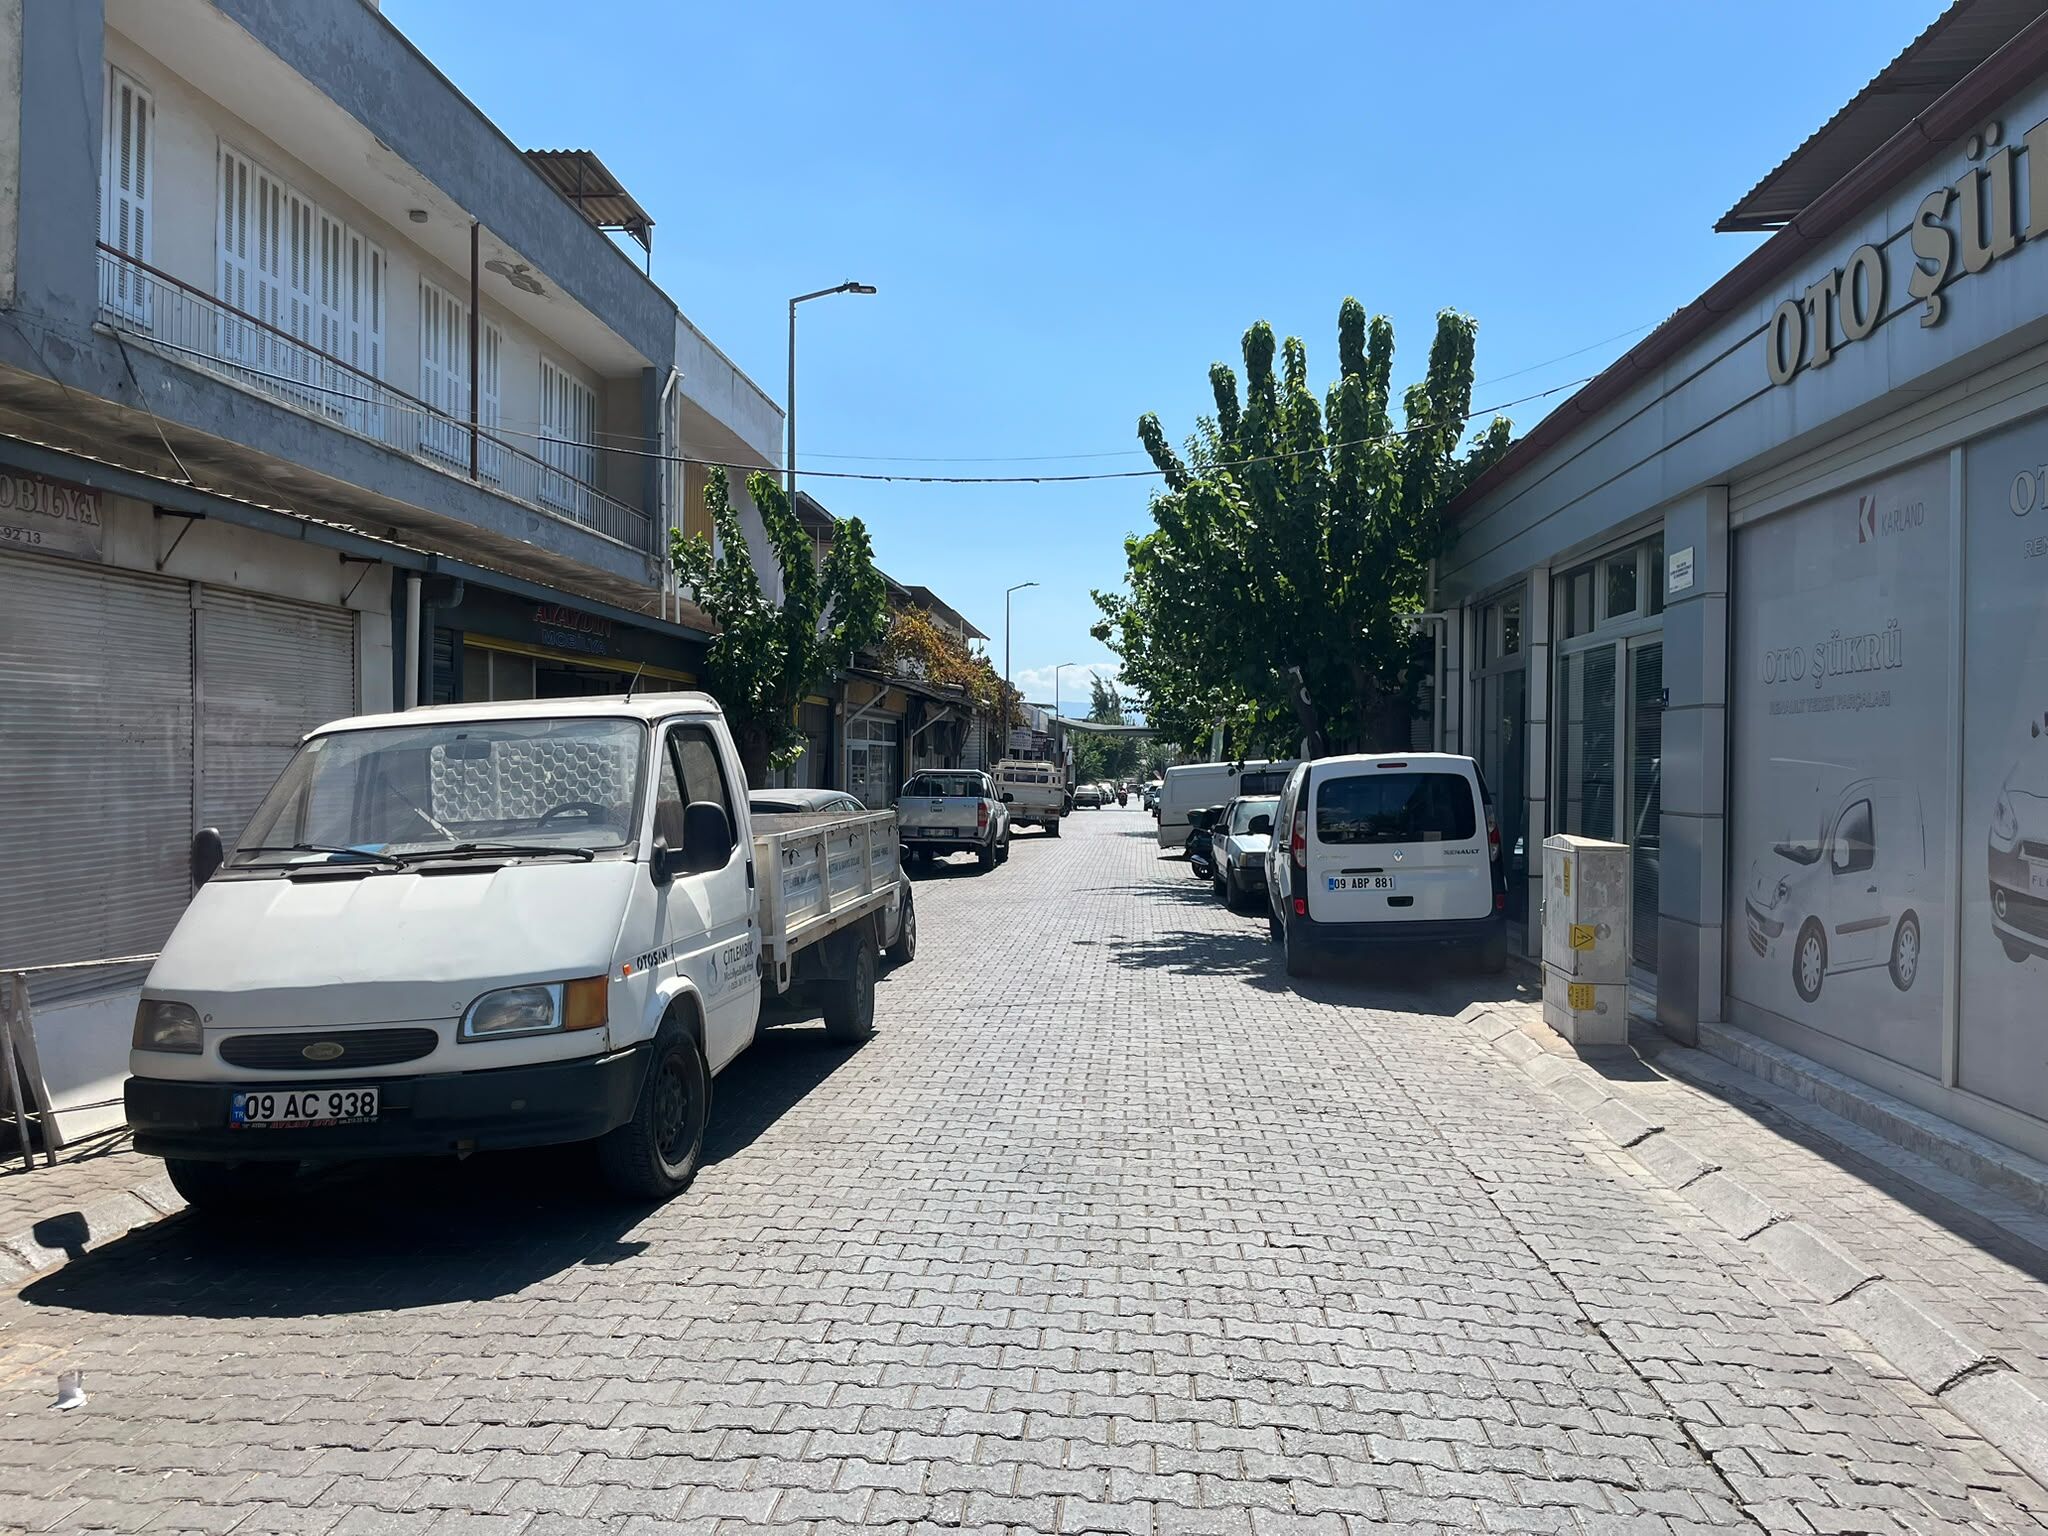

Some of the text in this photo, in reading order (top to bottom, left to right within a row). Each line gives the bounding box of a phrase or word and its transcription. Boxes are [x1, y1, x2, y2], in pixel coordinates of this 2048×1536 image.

[1766, 244, 1883, 386] OTO
[1881, 502, 1924, 536] KARLAND
[26, 531, 41, 544] 13
[1762, 618, 1902, 689] OTO ŞÜKRÜ
[1334, 878, 1393, 889] 09 ABP 881
[637, 948, 668, 971] OTOSAN
[245, 1092, 375, 1120] 09 AC 938
